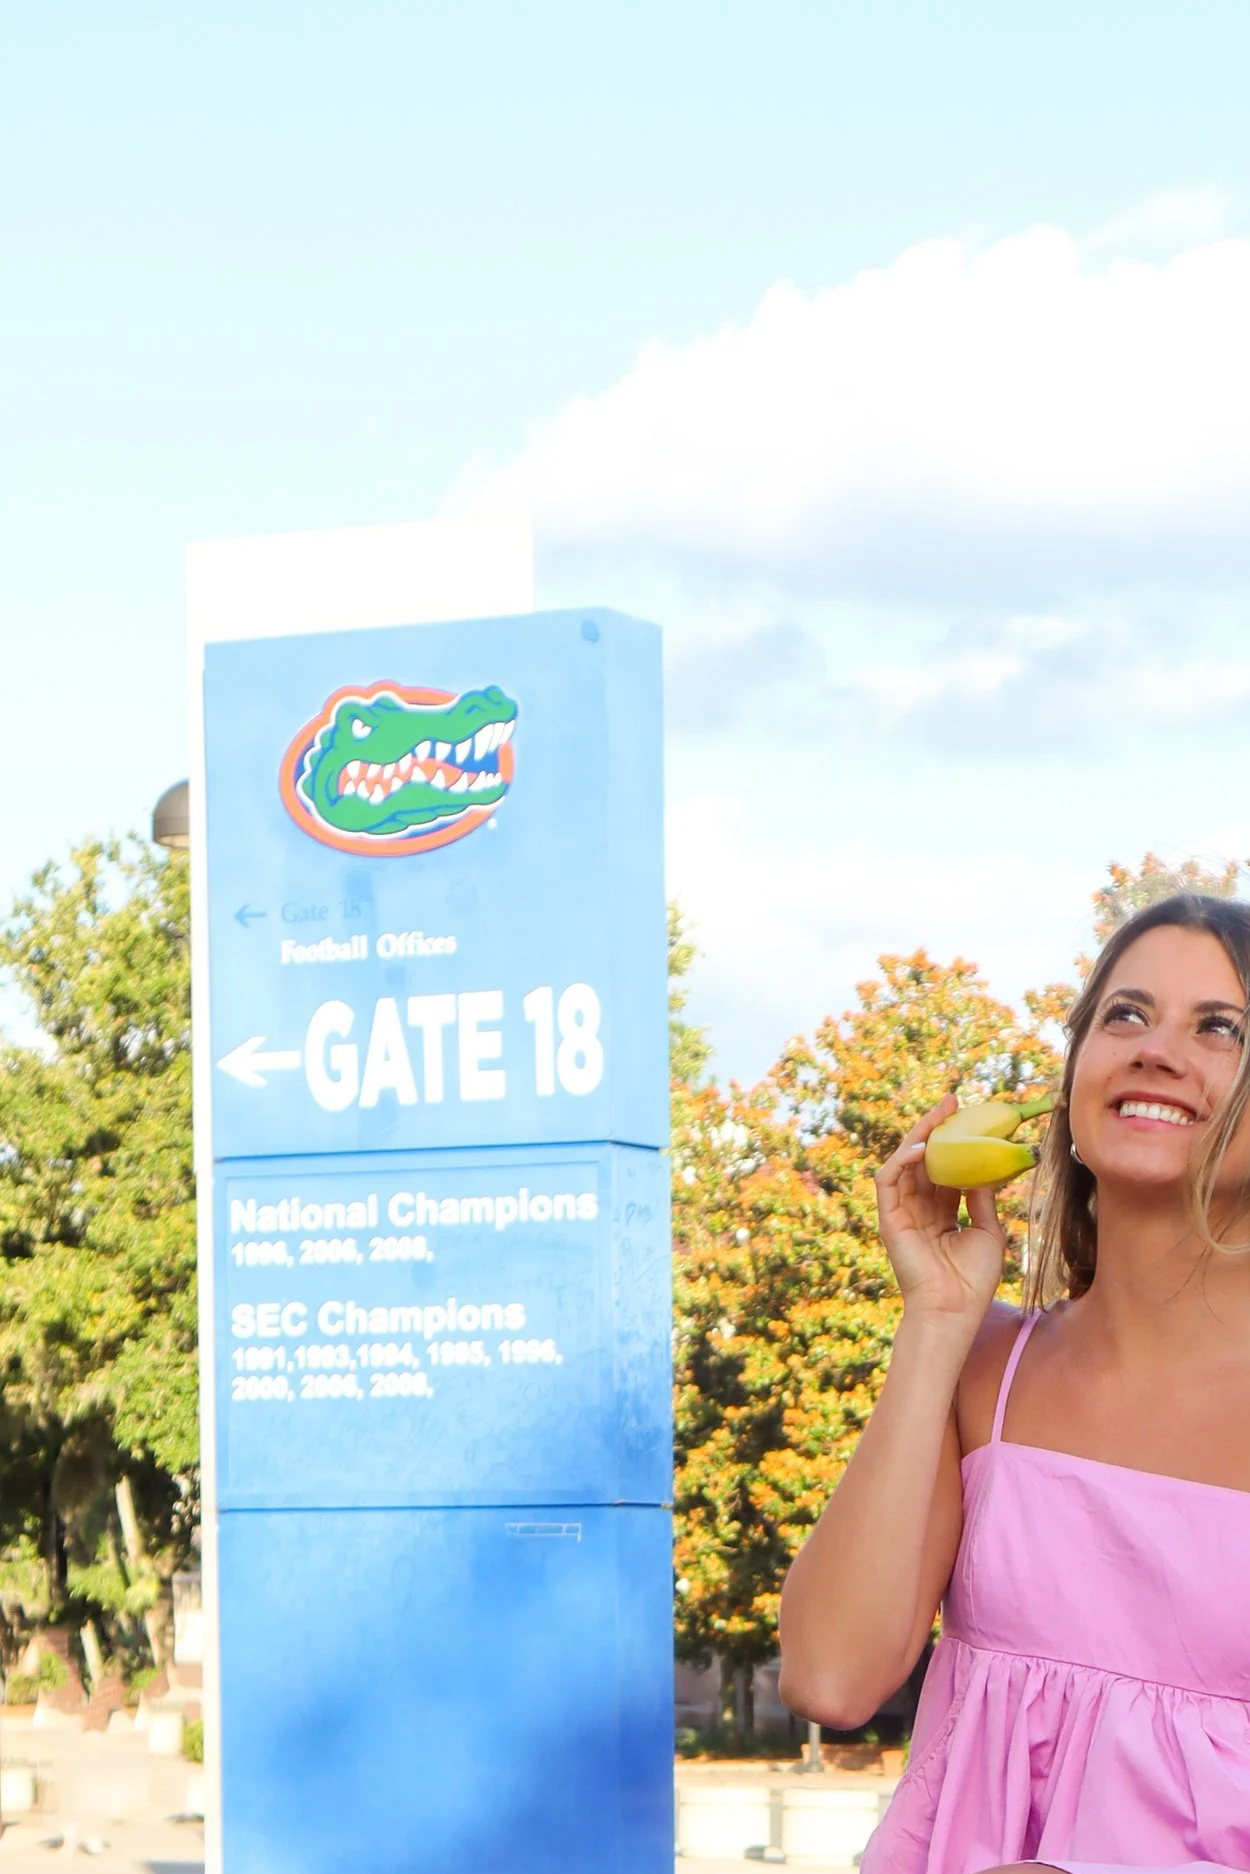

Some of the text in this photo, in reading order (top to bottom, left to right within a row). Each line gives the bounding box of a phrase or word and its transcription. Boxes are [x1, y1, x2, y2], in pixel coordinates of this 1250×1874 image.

[281, 900, 329, 923] Gate
[281, 931, 457, 965] Football Offices
[304, 981, 604, 1113] GATE 18
[230, 1193, 377, 1234] National
[387, 1187, 598, 1230] Champions
[231, 1297, 526, 1341] SEC Champions
